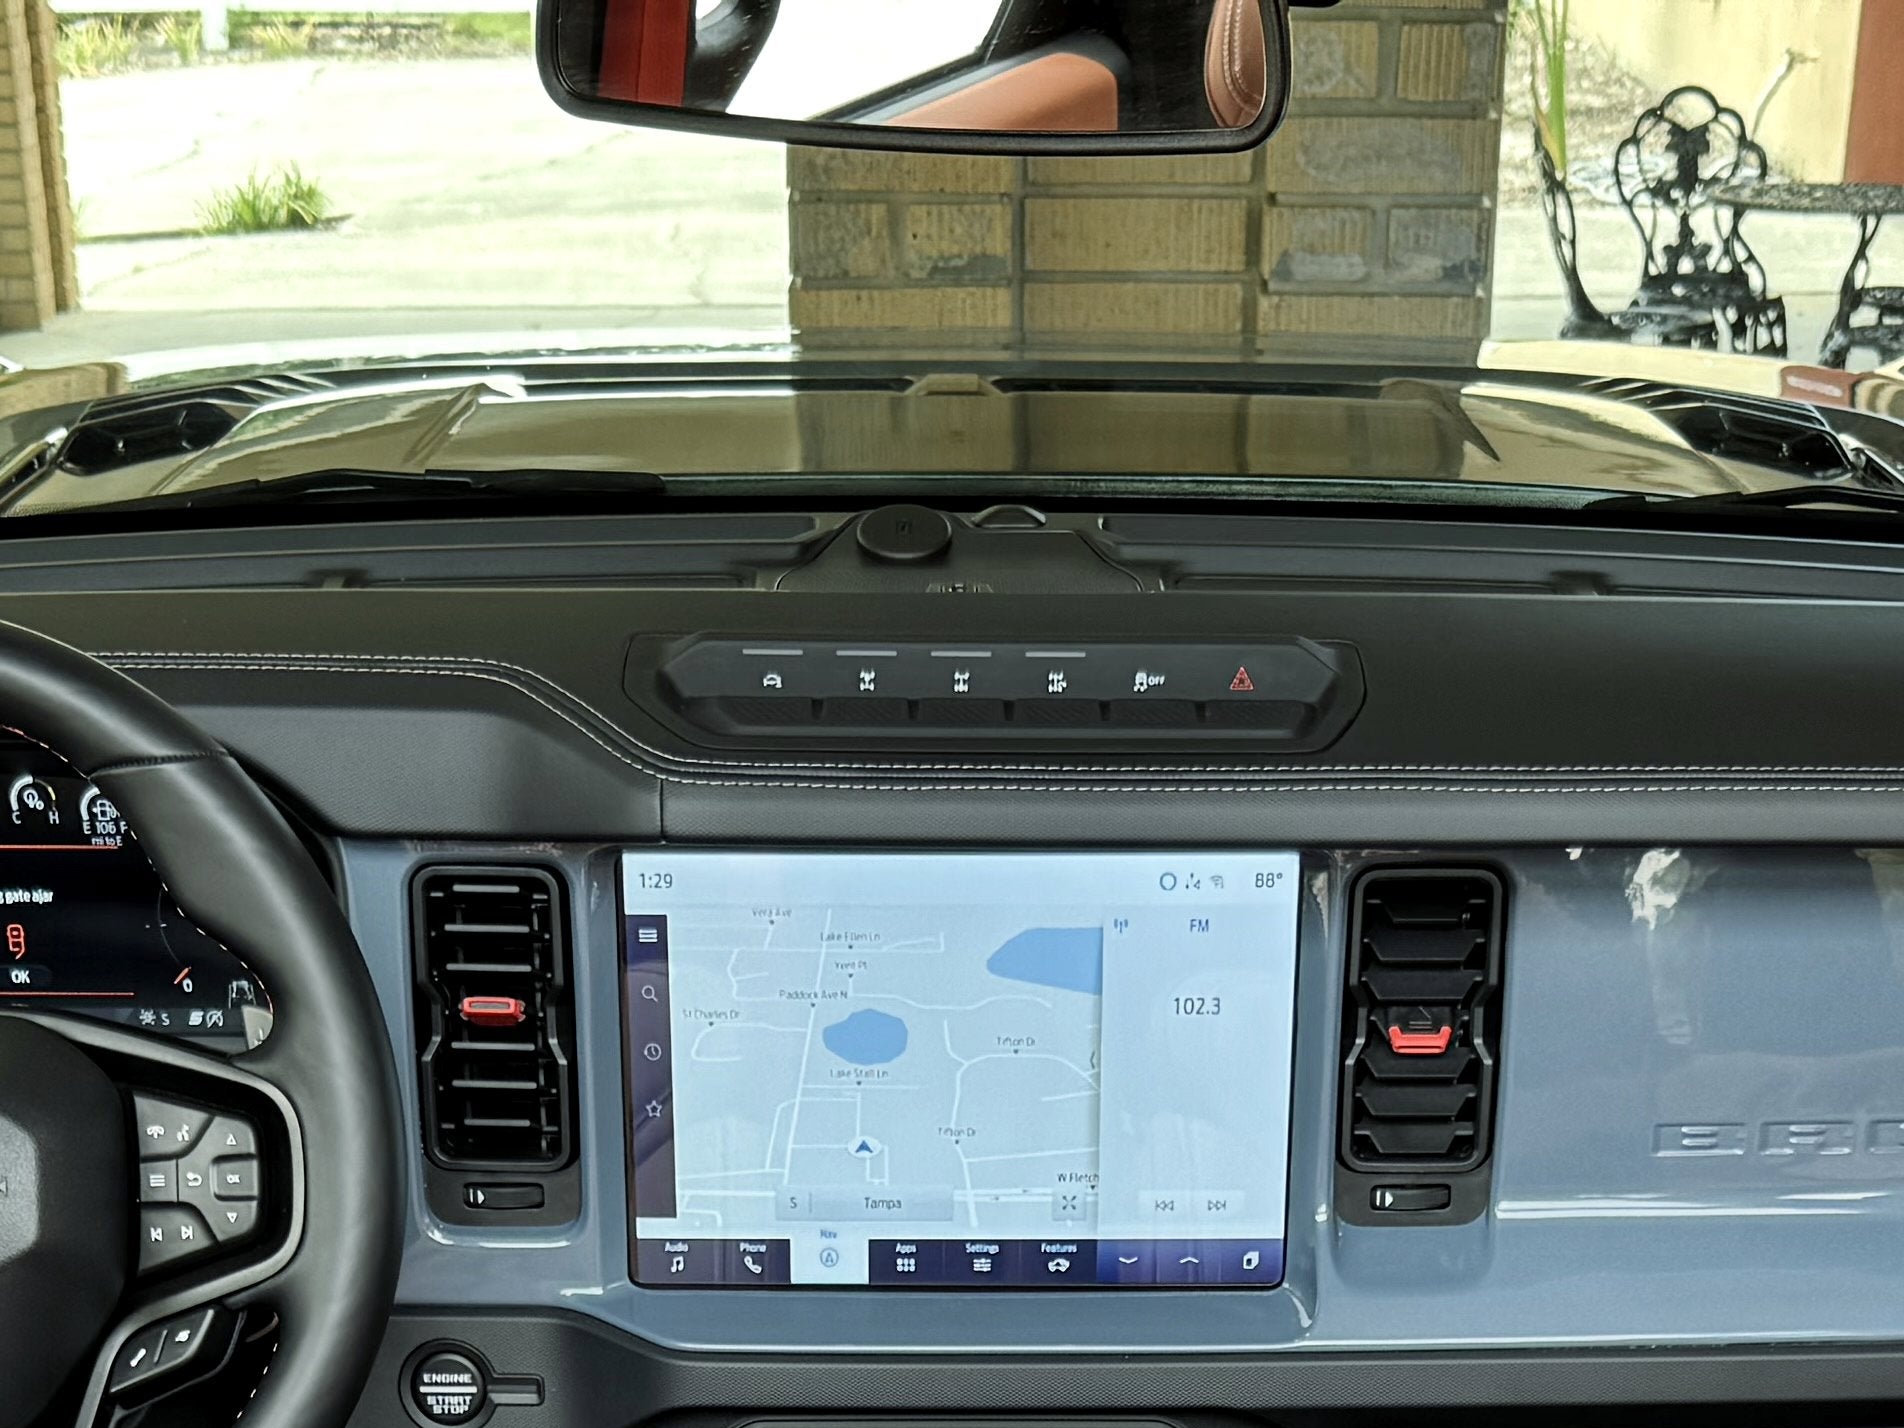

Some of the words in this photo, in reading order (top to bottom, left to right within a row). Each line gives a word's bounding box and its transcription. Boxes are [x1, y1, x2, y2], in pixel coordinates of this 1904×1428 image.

[12, 812, 21, 824] C
[49, 812, 59, 824] H
[83, 822, 91, 834] E
[96, 822, 116, 834] 106
[639, 873, 673, 889] 1:29
[1254, 873, 1283, 888] 88°
[5, 888, 31, 904] gate
[32, 888, 53, 904] ajar
[1190, 919, 1210, 933] FM
[11, 969, 30, 984] OK
[183, 978, 193, 993] 0
[779, 990, 818, 999] Paddock
[821, 990, 839, 999] Ave
[1173, 997, 1221, 1016] 102.3
[1057, 1173, 1067, 1183] W
[790, 1197, 797, 1209] S
[864, 1197, 902, 1211] Tampa
[665, 1242, 689, 1253] Audio
[740, 1242, 767, 1253] Phone
[895, 1243, 917, 1255] Apps
[966, 1243, 1000, 1255] Settings
[1041, 1243, 1077, 1254] Features
[423, 1373, 472, 1383] ENGINE
[427, 1395, 472, 1405] START
[433, 1404, 469, 1414] STOP
